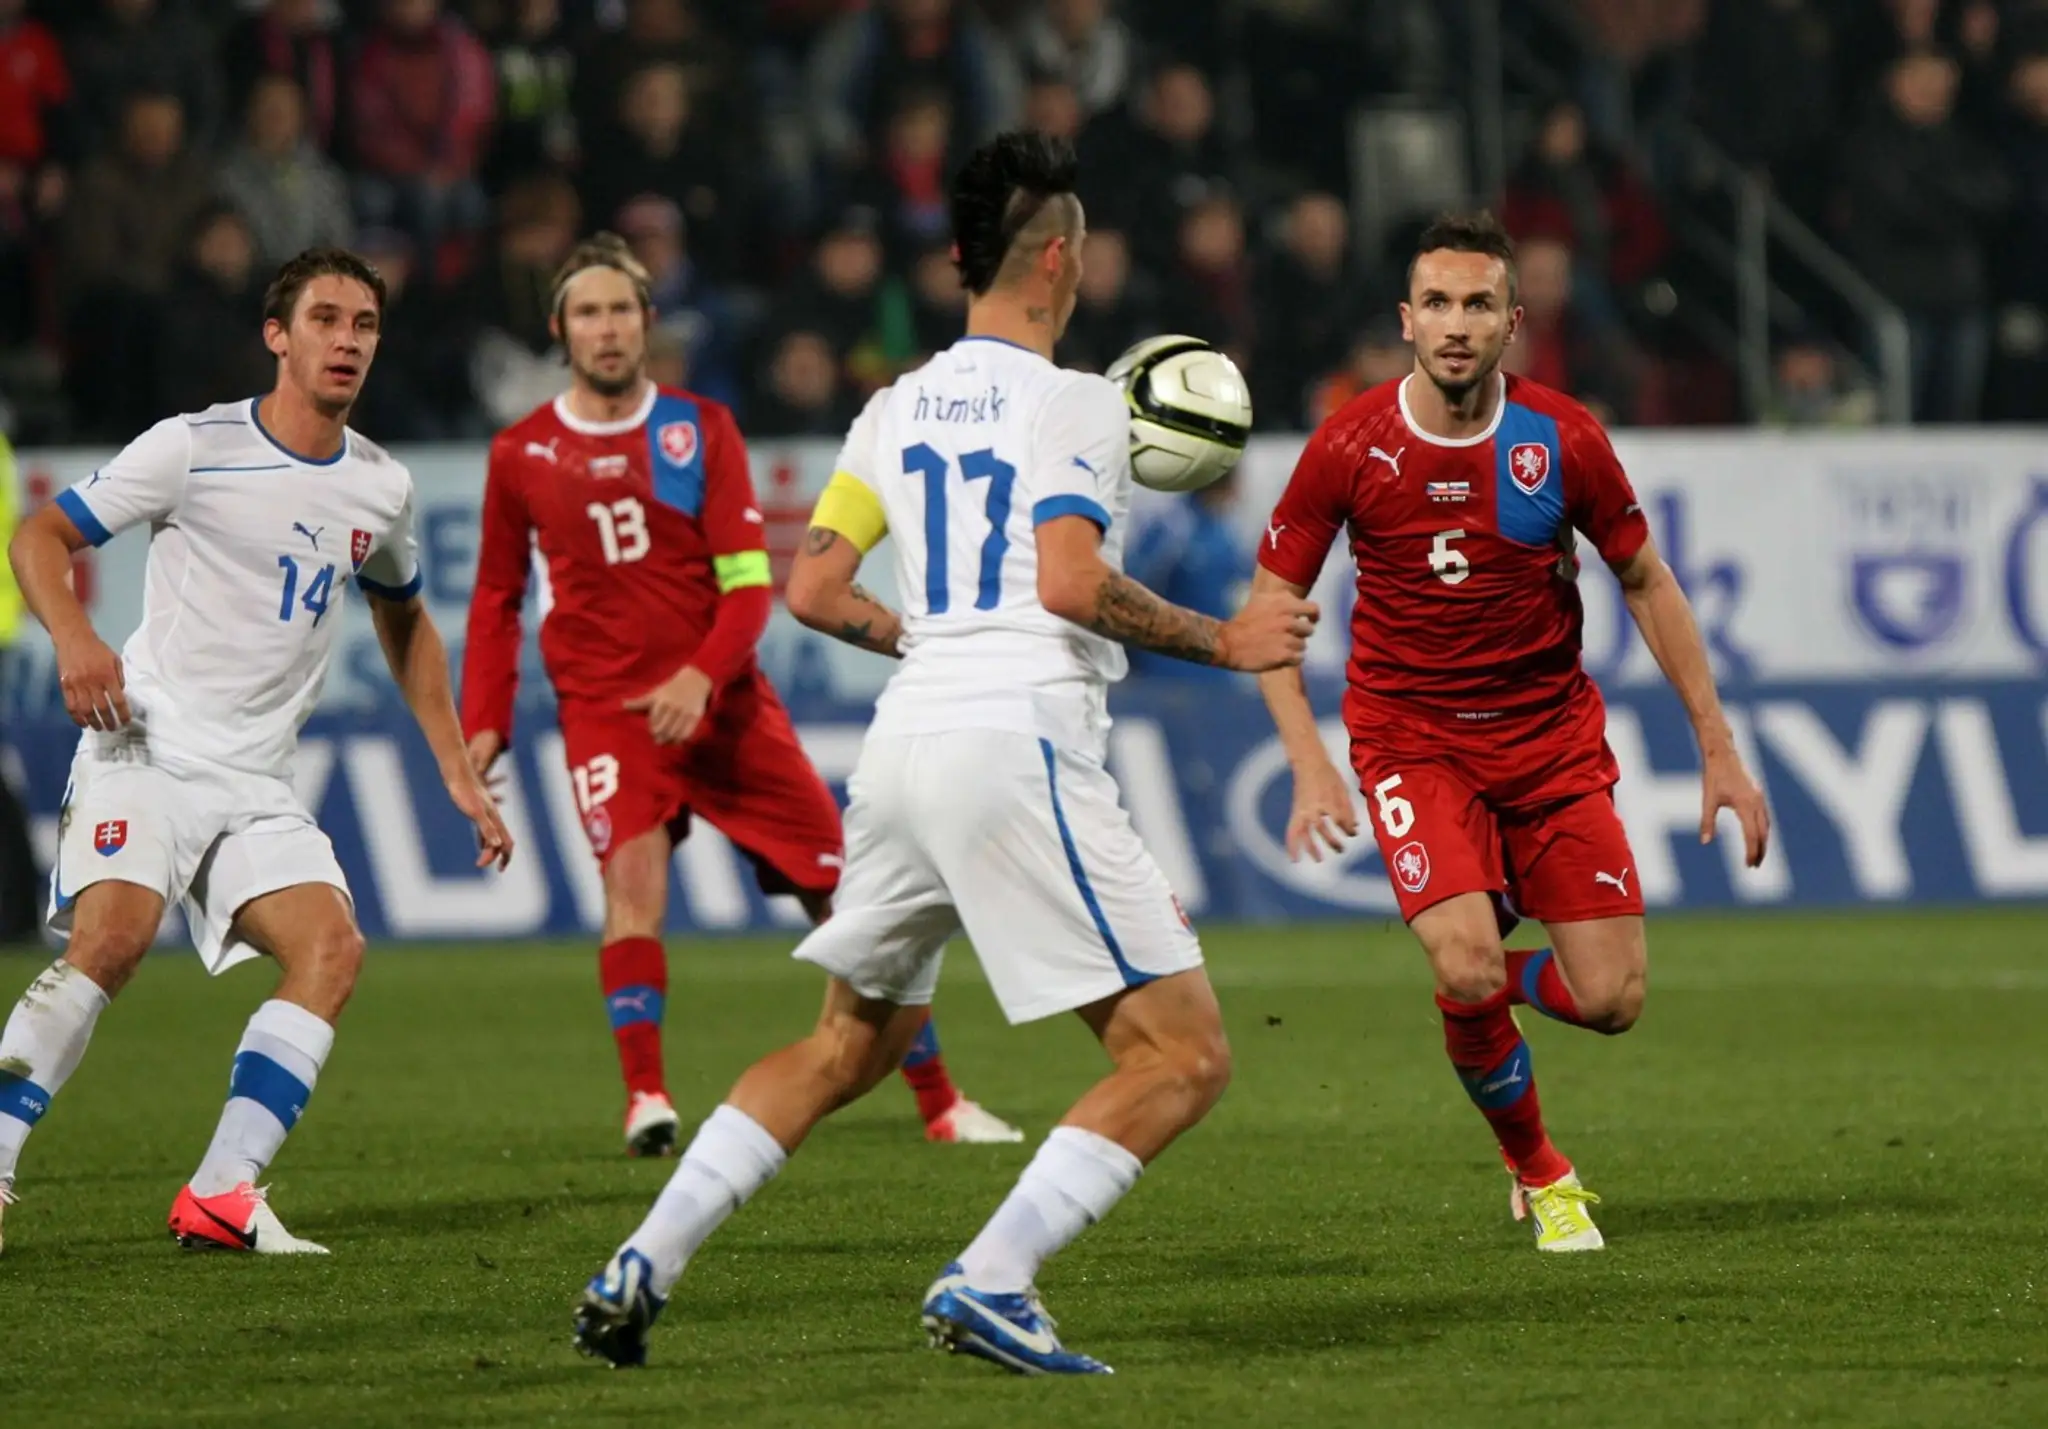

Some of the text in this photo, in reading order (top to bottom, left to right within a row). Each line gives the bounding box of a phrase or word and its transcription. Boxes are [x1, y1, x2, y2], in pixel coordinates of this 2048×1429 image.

[586, 497, 650, 564] 13
[902, 442, 1016, 615] 17
[1427, 529, 1469, 585] 6
[277, 554, 335, 628] 14
[572, 754, 619, 810] 13
[1375, 774, 1415, 837] 6
